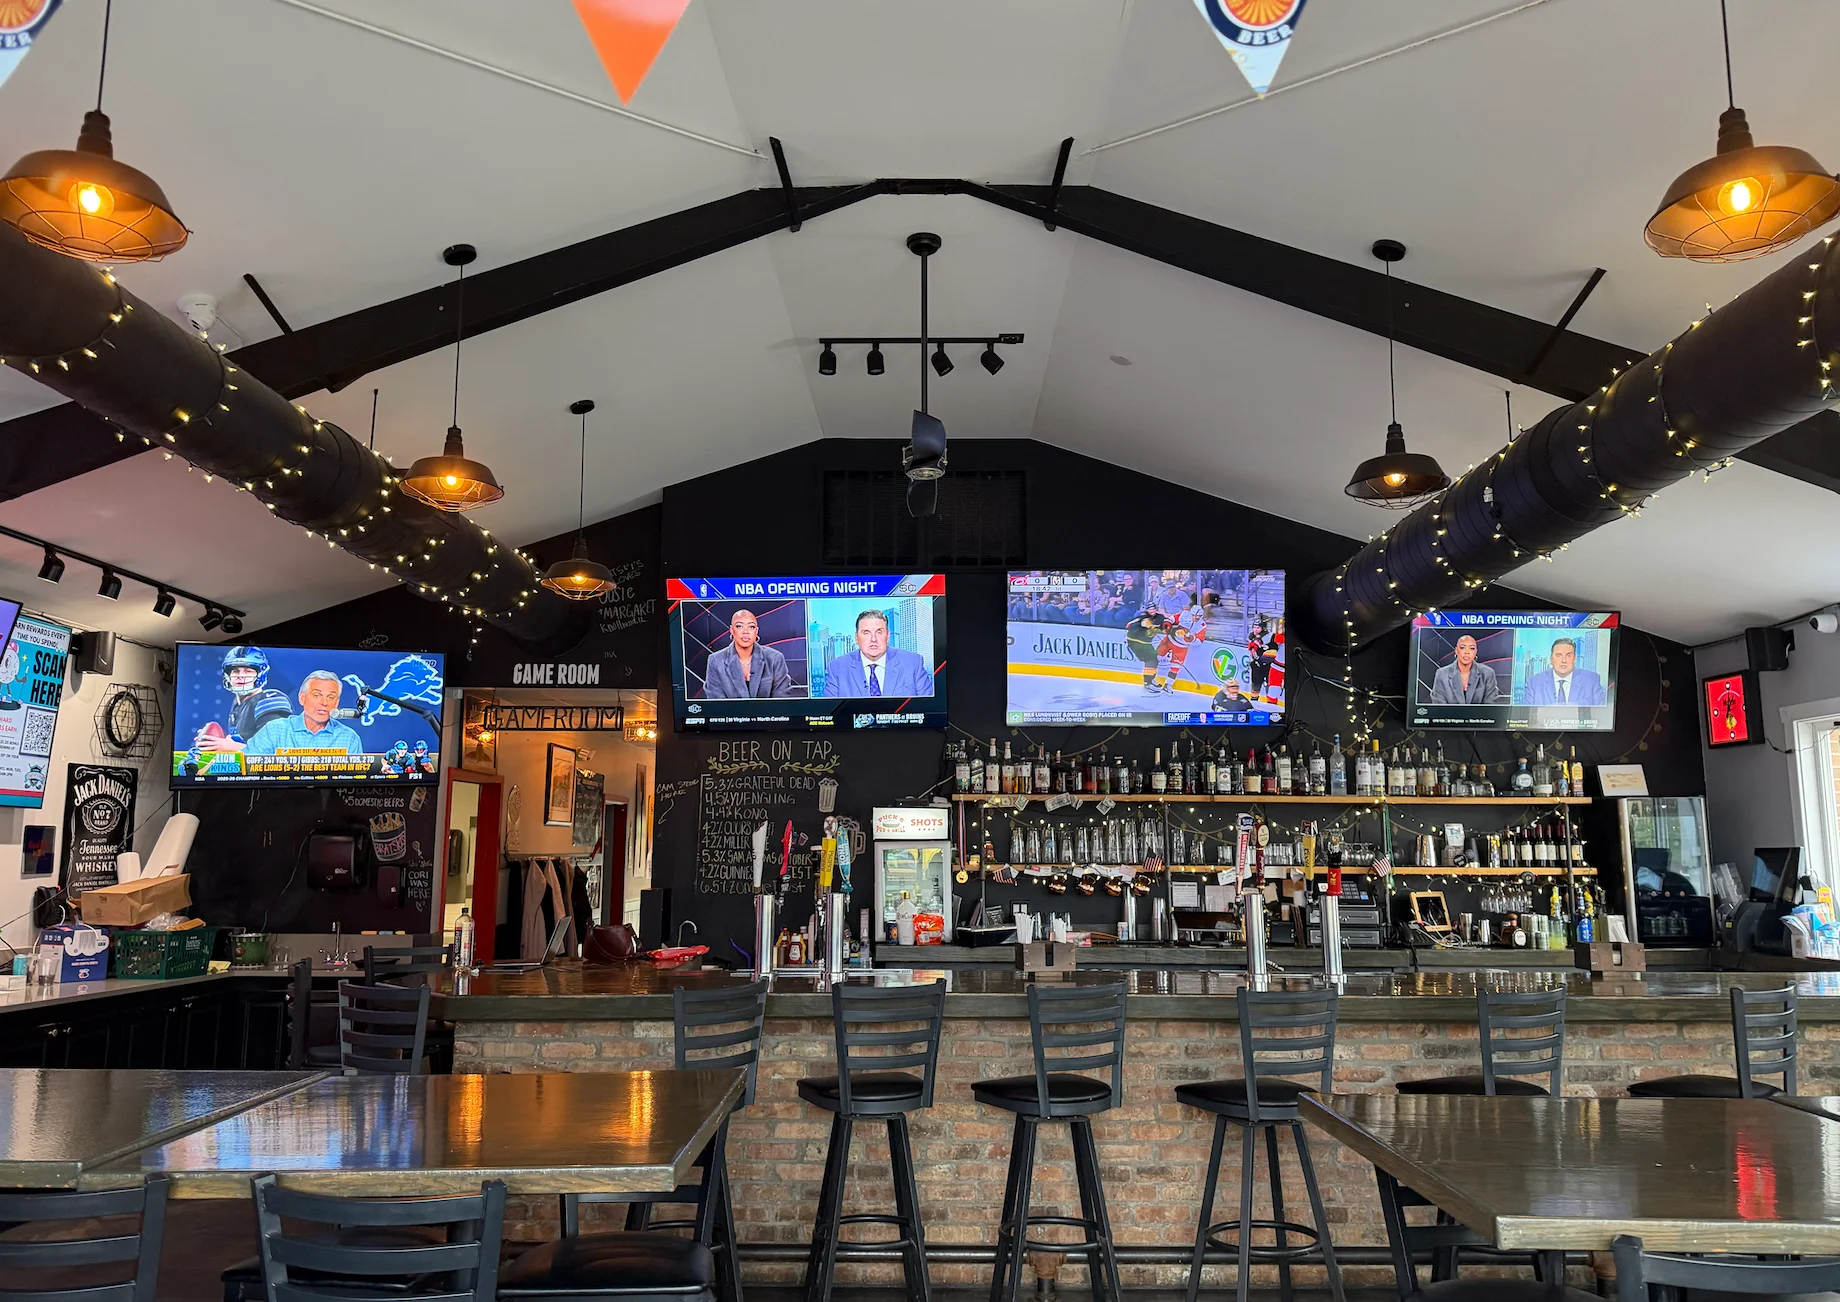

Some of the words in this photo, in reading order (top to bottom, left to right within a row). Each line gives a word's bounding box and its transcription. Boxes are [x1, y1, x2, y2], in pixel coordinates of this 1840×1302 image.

[1237, 24, 1293, 46] BEER
[734, 582, 764, 595] NBA
[768, 582, 830, 594] OPENING
[834, 582, 877, 594] NIGHT
[1462, 614, 1484, 624] NBA
[1486, 614, 1534, 624] OPENING
[1536, 615, 1570, 625] NIGHT
[17, 632, 28, 640] TIME
[30, 634, 40, 644] YOU
[26, 624, 50, 637] REWARDS
[50, 630, 66, 640] EVERY
[1033, 633, 1072, 656] JACK
[1076, 639, 1136, 662] DANIEL'S
[33, 650, 67, 680] SCAN
[513, 663, 554, 685] GAME
[557, 664, 600, 685] ROOM
[1168, 712, 1191, 720] FACEOFF
[719, 741, 760, 762] BEER
[771, 740, 792, 760] ON
[802, 740, 832, 760] TAP
[216, 754, 236, 763] LION
[246, 756, 264, 764] GOFF:
[302, 756, 320, 764] GIBBS:
[210, 763, 240, 773] KINGS
[250, 764, 264, 772] ARE
[264, 764, 283, 772] LIONS
[704, 778, 734, 790] 5.3%
[735, 776, 785, 790] GRATEFUL
[790, 776, 816, 790] DEAD
[74, 779, 98, 806] JACK
[98, 774, 132, 808] DANIEL'S
[384, 798, 404, 808] BEERS
[910, 818, 944, 826] SHOTS
[79, 840, 118, 854] Tennessee
[724, 836, 751, 850] MILLER
[728, 850, 744, 864] SAM
[838, 846, 846, 866] KONA
[76, 862, 118, 872] WHISKEY
[720, 864, 754, 880] GUINNES
[408, 871, 428, 880] CORI
[410, 880, 428, 888] WAS
[408, 888, 431, 899] HERE
